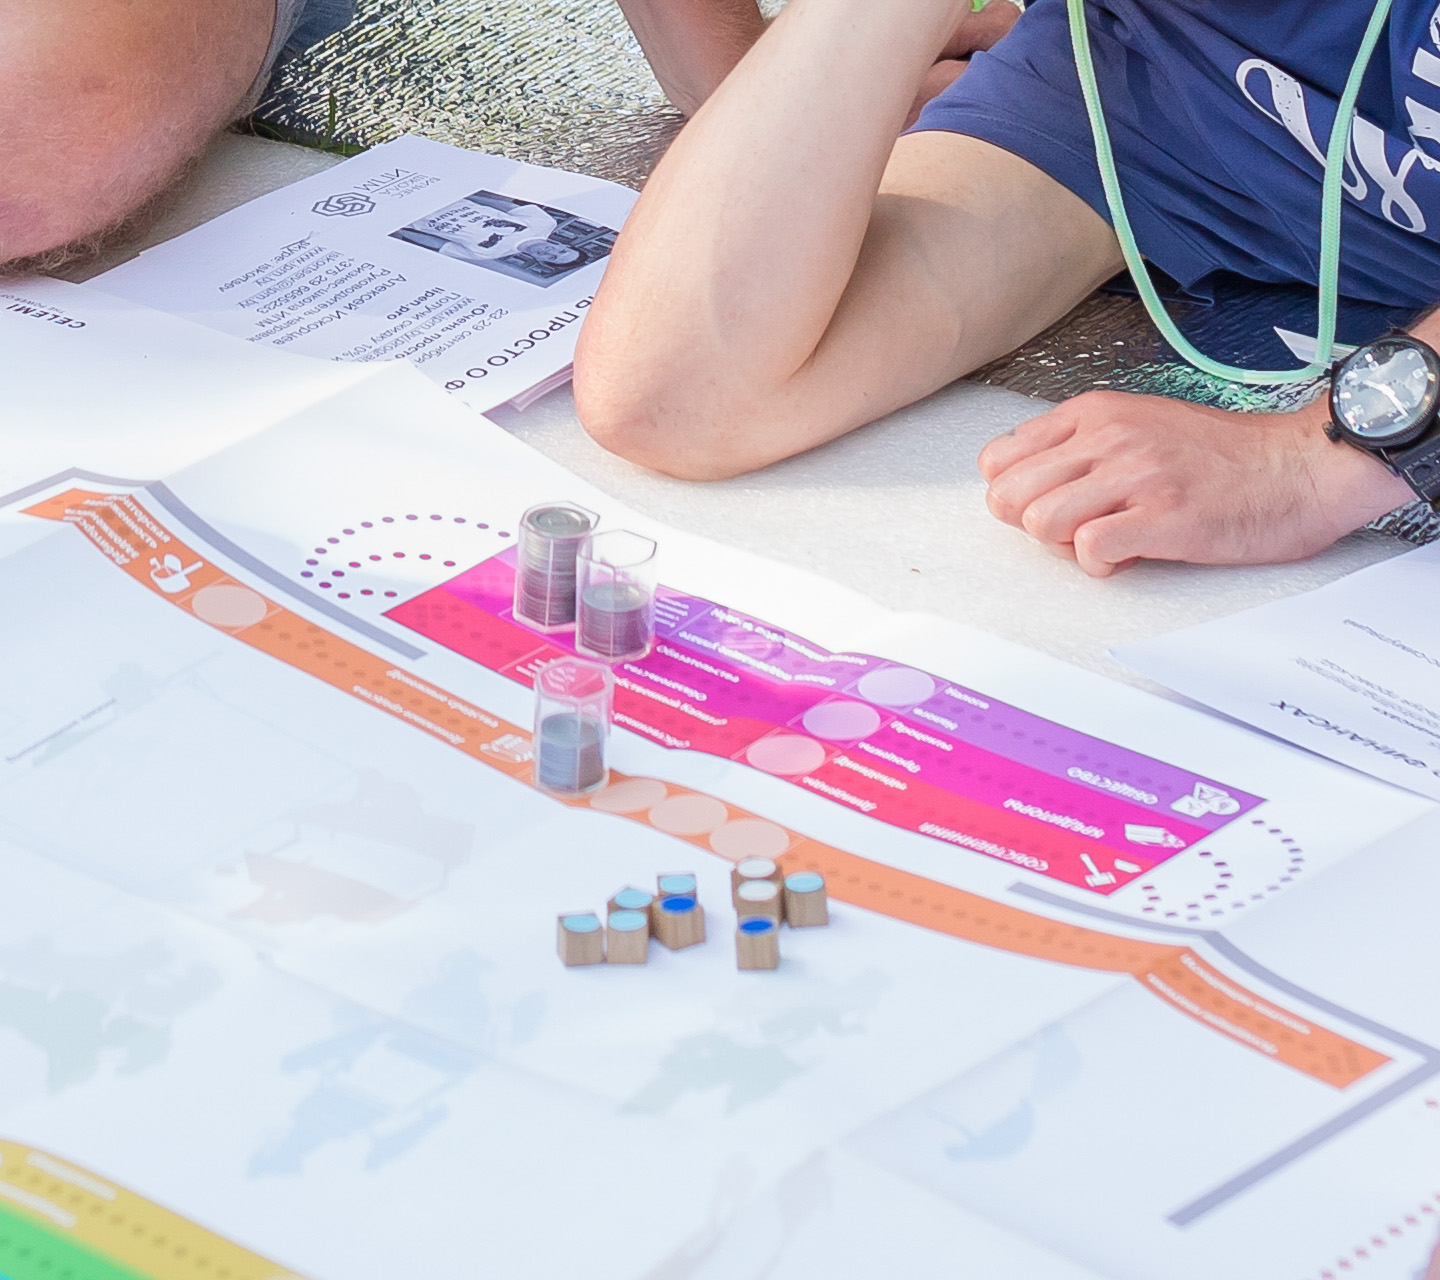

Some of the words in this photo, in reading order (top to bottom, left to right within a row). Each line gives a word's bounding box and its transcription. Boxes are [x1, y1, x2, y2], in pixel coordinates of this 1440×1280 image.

[342, 273, 407, 311] Алексей
[386, 286, 446, 320] lipen.pro
[6, 303, 87, 329] CELEMI
[254, 310, 292, 328] ИПМ
[486, 310, 580, 367] ПРОСТО
[465, 367, 489, 379] О
[1269, 699, 1428, 768] ФИНАНСАХ
[1066, 766, 1159, 805] ОБЩЕСТВО
[1003, 797, 1105, 839] КРЕДИТОРЫ
[919, 822, 1050, 872] СОБСТВЕННИКИ
